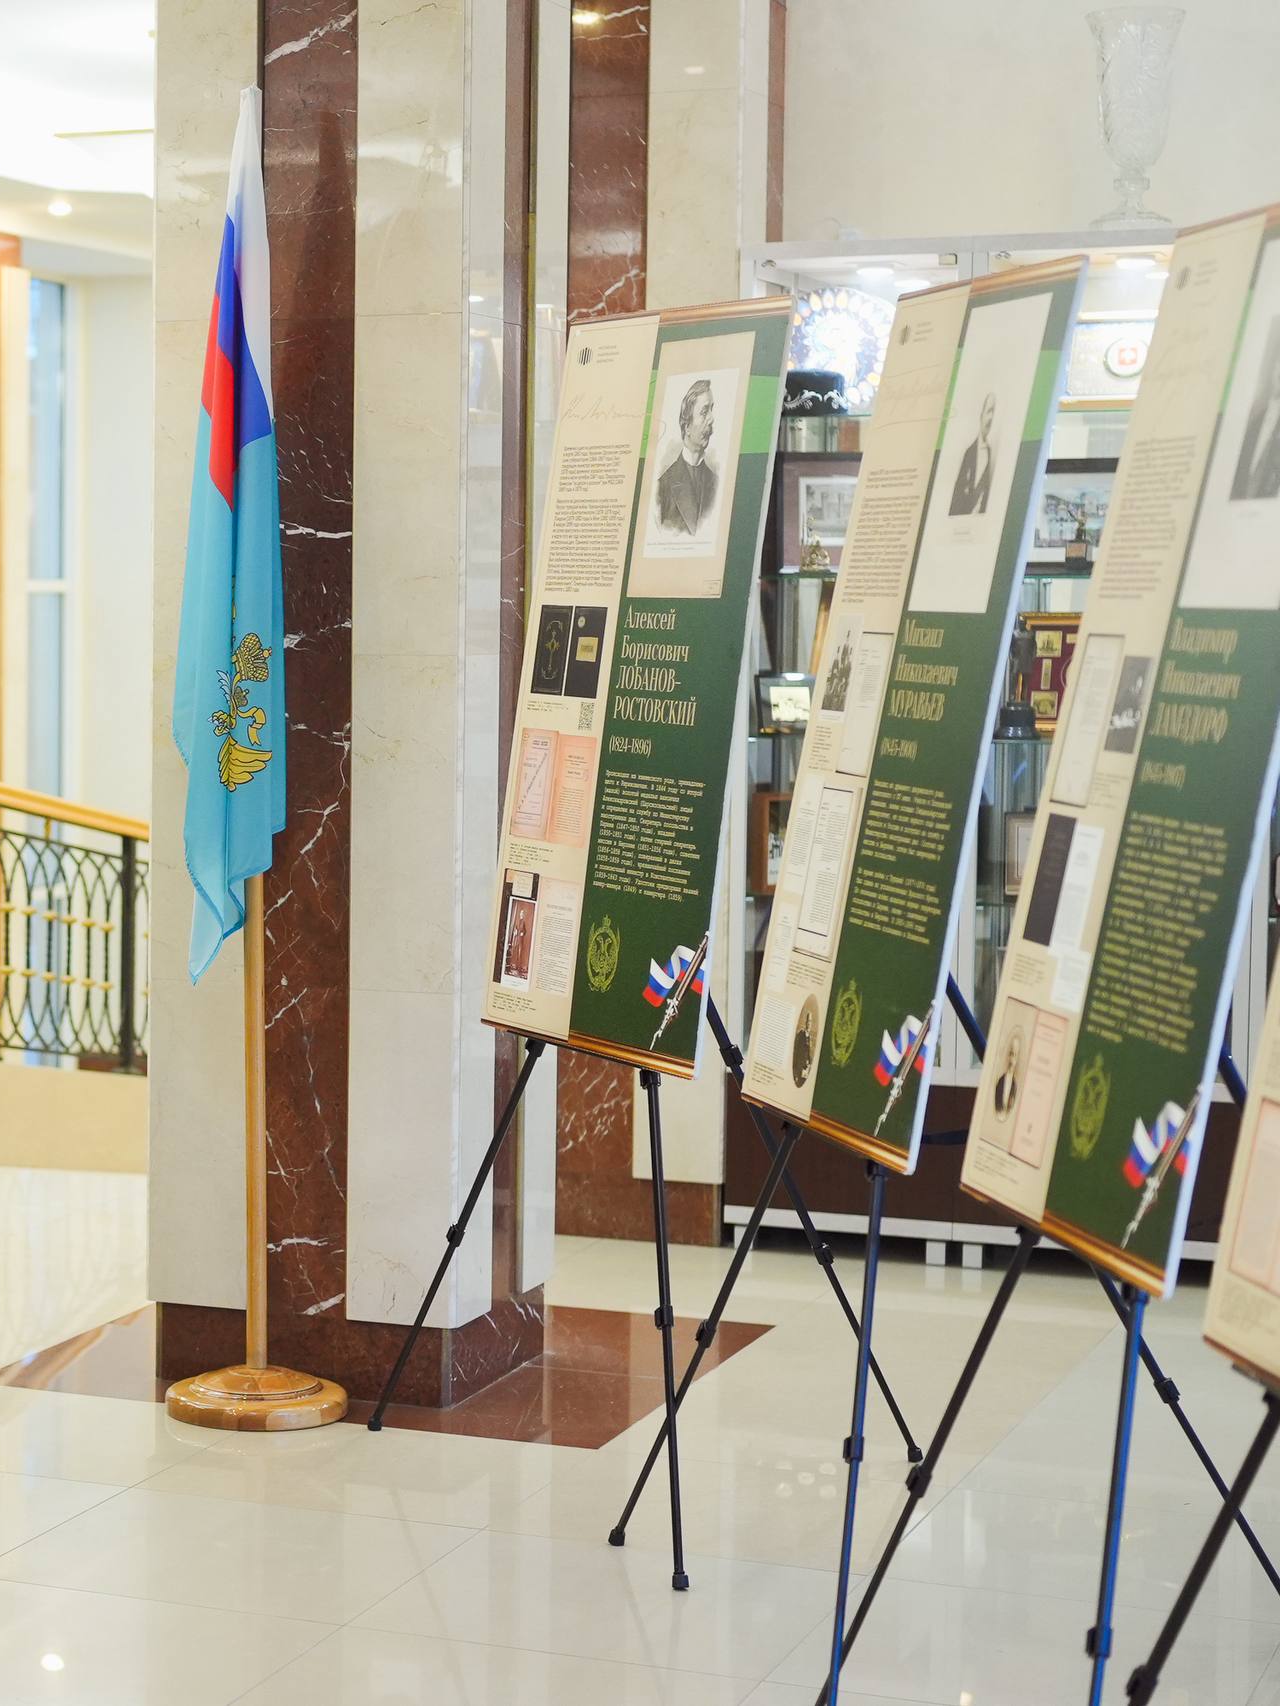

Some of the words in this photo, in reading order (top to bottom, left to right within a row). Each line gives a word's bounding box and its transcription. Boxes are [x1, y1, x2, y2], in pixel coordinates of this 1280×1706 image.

[624, 605, 677, 631] Алексей
[901, 619, 945, 649] Михаил
[621, 635, 690, 666] Борисович
[616, 665, 682, 693] ЛОБАНОВ-
[894, 654, 959, 686] Николаевич
[613, 696, 697, 727] РОСТОВСКИЙ
[609, 734, 652, 758] (1824-1896)
